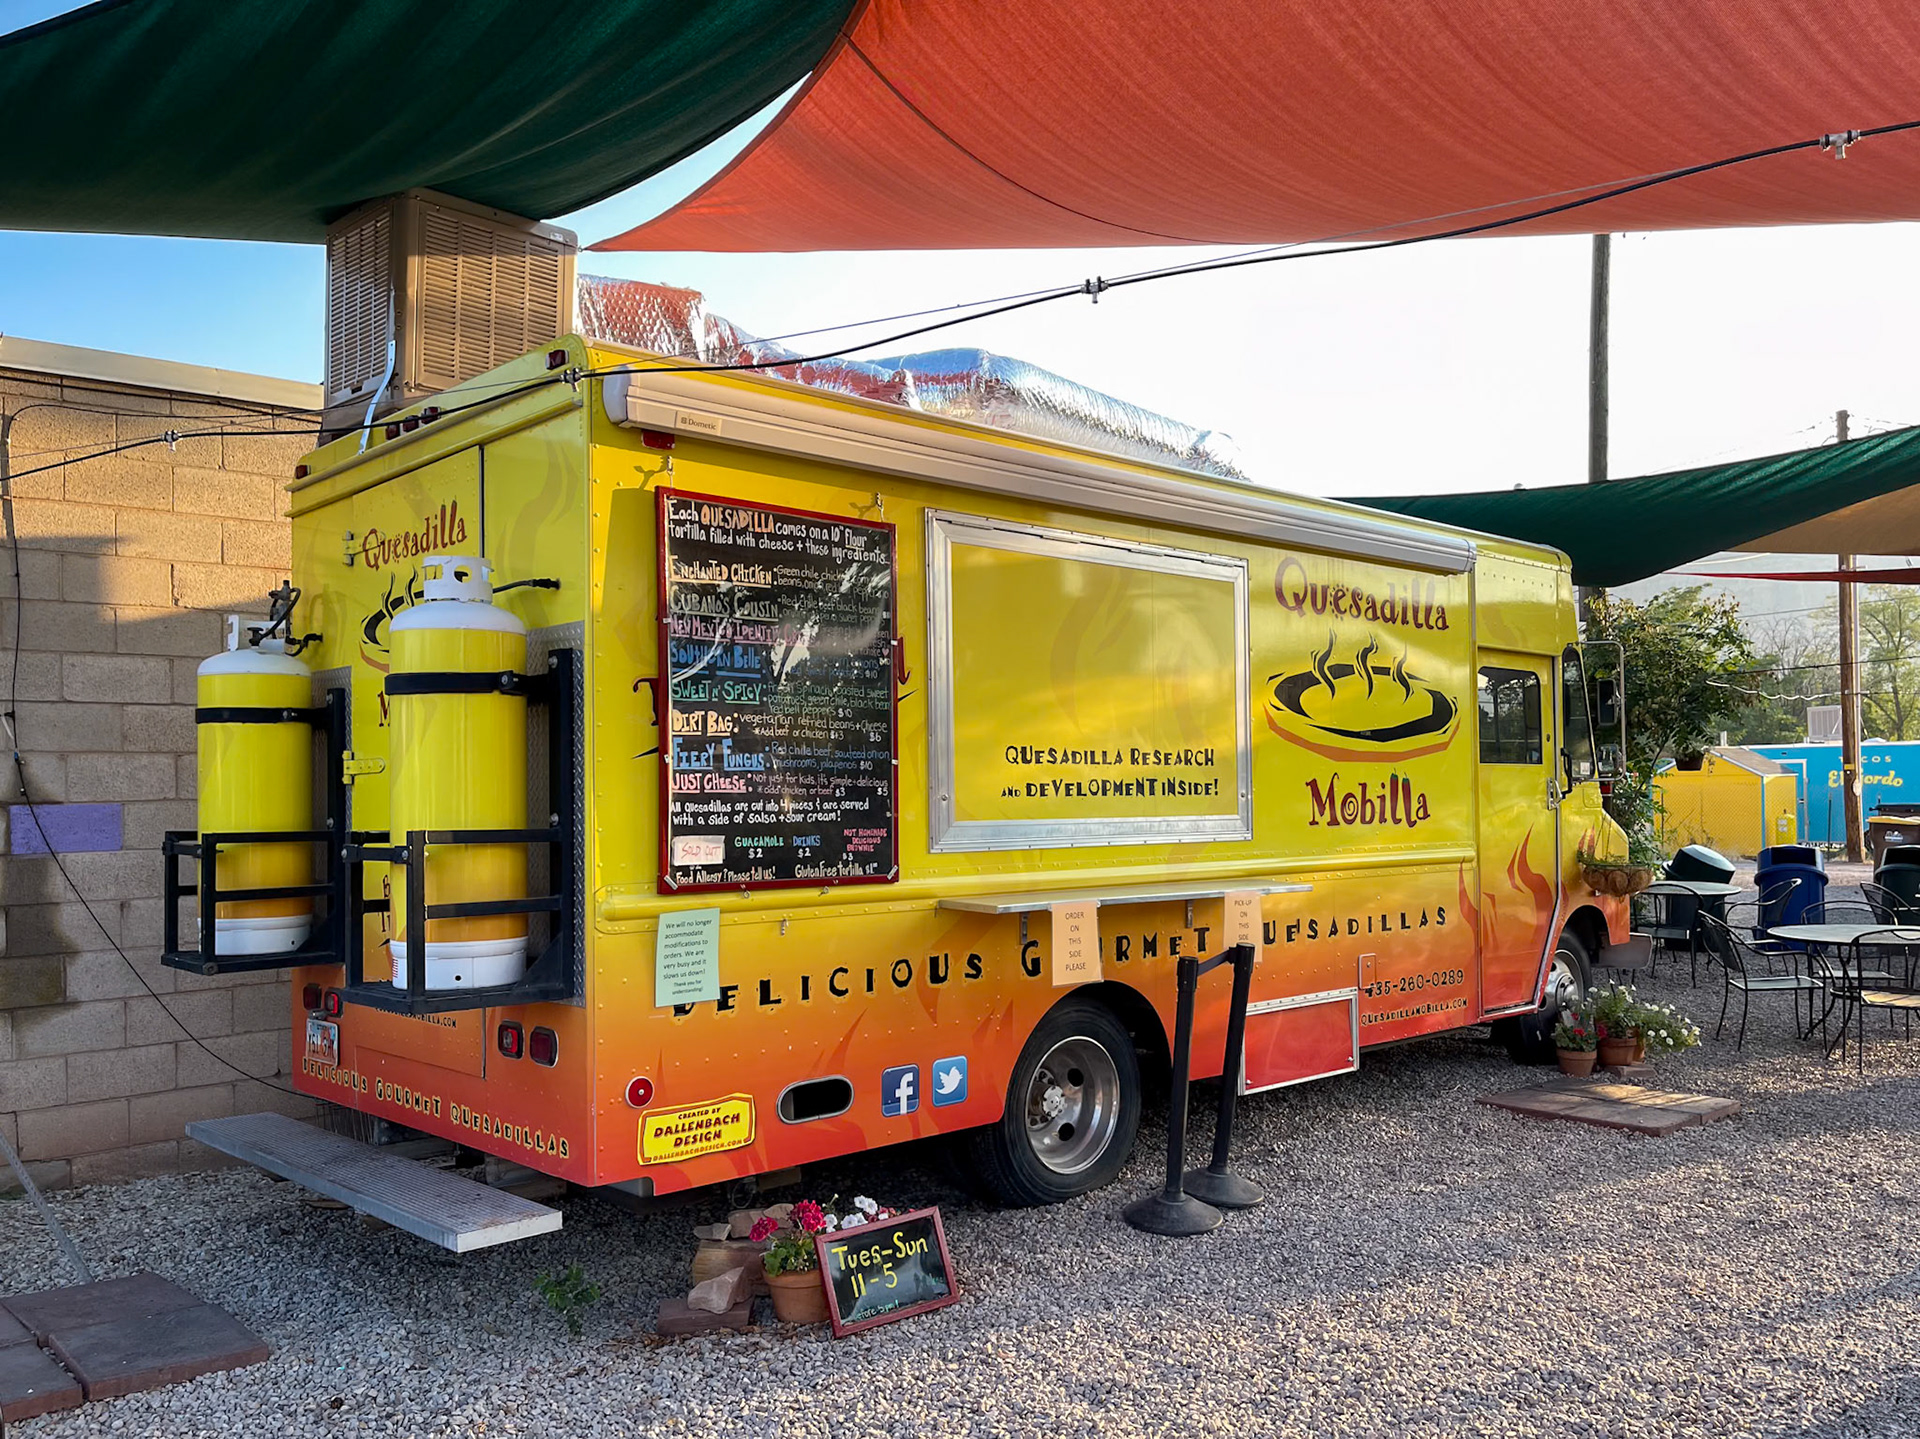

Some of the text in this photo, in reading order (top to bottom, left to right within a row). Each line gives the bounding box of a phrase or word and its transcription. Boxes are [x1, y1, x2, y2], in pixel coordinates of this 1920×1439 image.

[688, 418, 717, 430] Dometic
[668, 499, 699, 521] Each
[701, 504, 775, 533] QUESADILLA
[775, 522, 806, 537] comes
[809, 526, 821, 540] on
[821, 529, 829, 540] a
[845, 528, 867, 549] flour
[362, 498, 468, 571] Quesadilla
[669, 520, 706, 541] tortilla
[710, 527, 733, 544] filled
[736, 531, 755, 547] with
[758, 533, 794, 551] cheese
[805, 538, 829, 556] these
[776, 563, 819, 579] Green chile
[1274, 556, 1450, 631] Quesadilla
[672, 680, 711, 698] SWEET
[785, 704, 800, 715] bell
[672, 709, 705, 732] DIRT
[739, 712, 794, 727] vegetarian
[829, 719, 855, 731] beans
[673, 737, 715, 767] FIERY
[788, 742, 811, 756] chile
[1005, 745, 1214, 767] QUESADILLA RESEARCH
[860, 760, 873, 771] $10
[672, 773, 702, 790] JUST
[768, 773, 784, 788] just
[785, 772, 798, 784] for
[857, 775, 888, 787] delicious
[1860, 768, 1903, 787] ordo
[1000, 786, 1021, 798] AND
[1026, 777, 1158, 798] DEVELOPMENT
[1305, 767, 1431, 828] Mobilla
[734, 802, 749, 812] are
[751, 800, 763, 812] cut
[765, 799, 780, 812] into
[780, 798, 788, 811] 4
[789, 800, 813, 815] pieces
[822, 801, 838, 810] are
[840, 797, 869, 811] served
[672, 812, 694, 826] with
[697, 815, 705, 825] a
[733, 812, 745, 824] of
[785, 812, 804, 823] sour
[734, 835, 784, 847] GUACAMOLE
[793, 835, 821, 846] DRINKS
[681, 842, 721, 859] SOLD OUT
[748, 848, 764, 859] $2
[797, 847, 812, 858] $2
[676, 870, 694, 884] Food
[751, 866, 762, 880] tell
[695, 919, 712, 927] longer
[1065, 911, 1085, 920] ORDER
[664, 930, 703, 940] accommodate
[1070, 924, 1080, 933] ON
[664, 940, 701, 949] modifications
[1020, 926, 1211, 978] GRMET
[1263, 906, 1447, 946] UESADILLAS
[1068, 937, 1082, 945] THIS
[1238, 933, 1249, 941] SIDE
[1068, 950, 1082, 958] SIDE
[663, 962, 676, 970] very
[677, 961, 690, 969] busy
[1065, 962, 1087, 971] PLEASE
[663, 972, 679, 980] slows
[1365, 969, 1464, 998] 435-260-0289
[302, 1056, 570, 1159] DELICIOUS GOURMET QUESADILLAS
[678, 1108, 709, 1120] CREATED
[653, 1113, 740, 1138] DALLENBACH
[673, 1130, 722, 1148] DESIGN
[831, 1231, 928, 1271] Tues-Sun
[850, 1262, 898, 1298] 11-5
